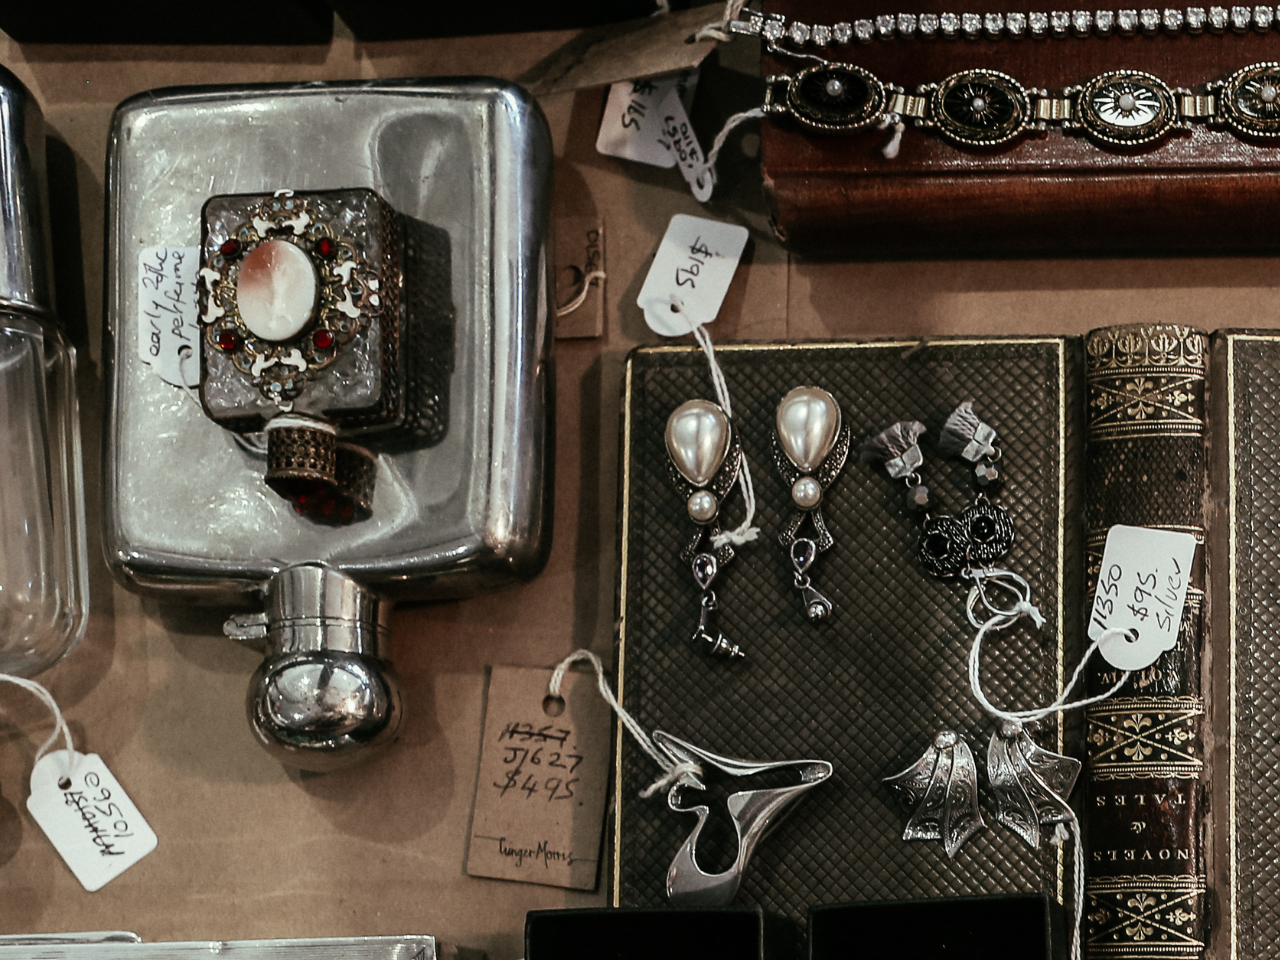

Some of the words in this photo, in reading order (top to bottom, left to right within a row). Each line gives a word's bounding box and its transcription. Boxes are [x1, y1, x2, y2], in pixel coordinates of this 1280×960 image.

[676, 236, 712, 289] $195
[1096, 793, 1186, 806] TALES
[1093, 848, 1190, 861] NOVELS
